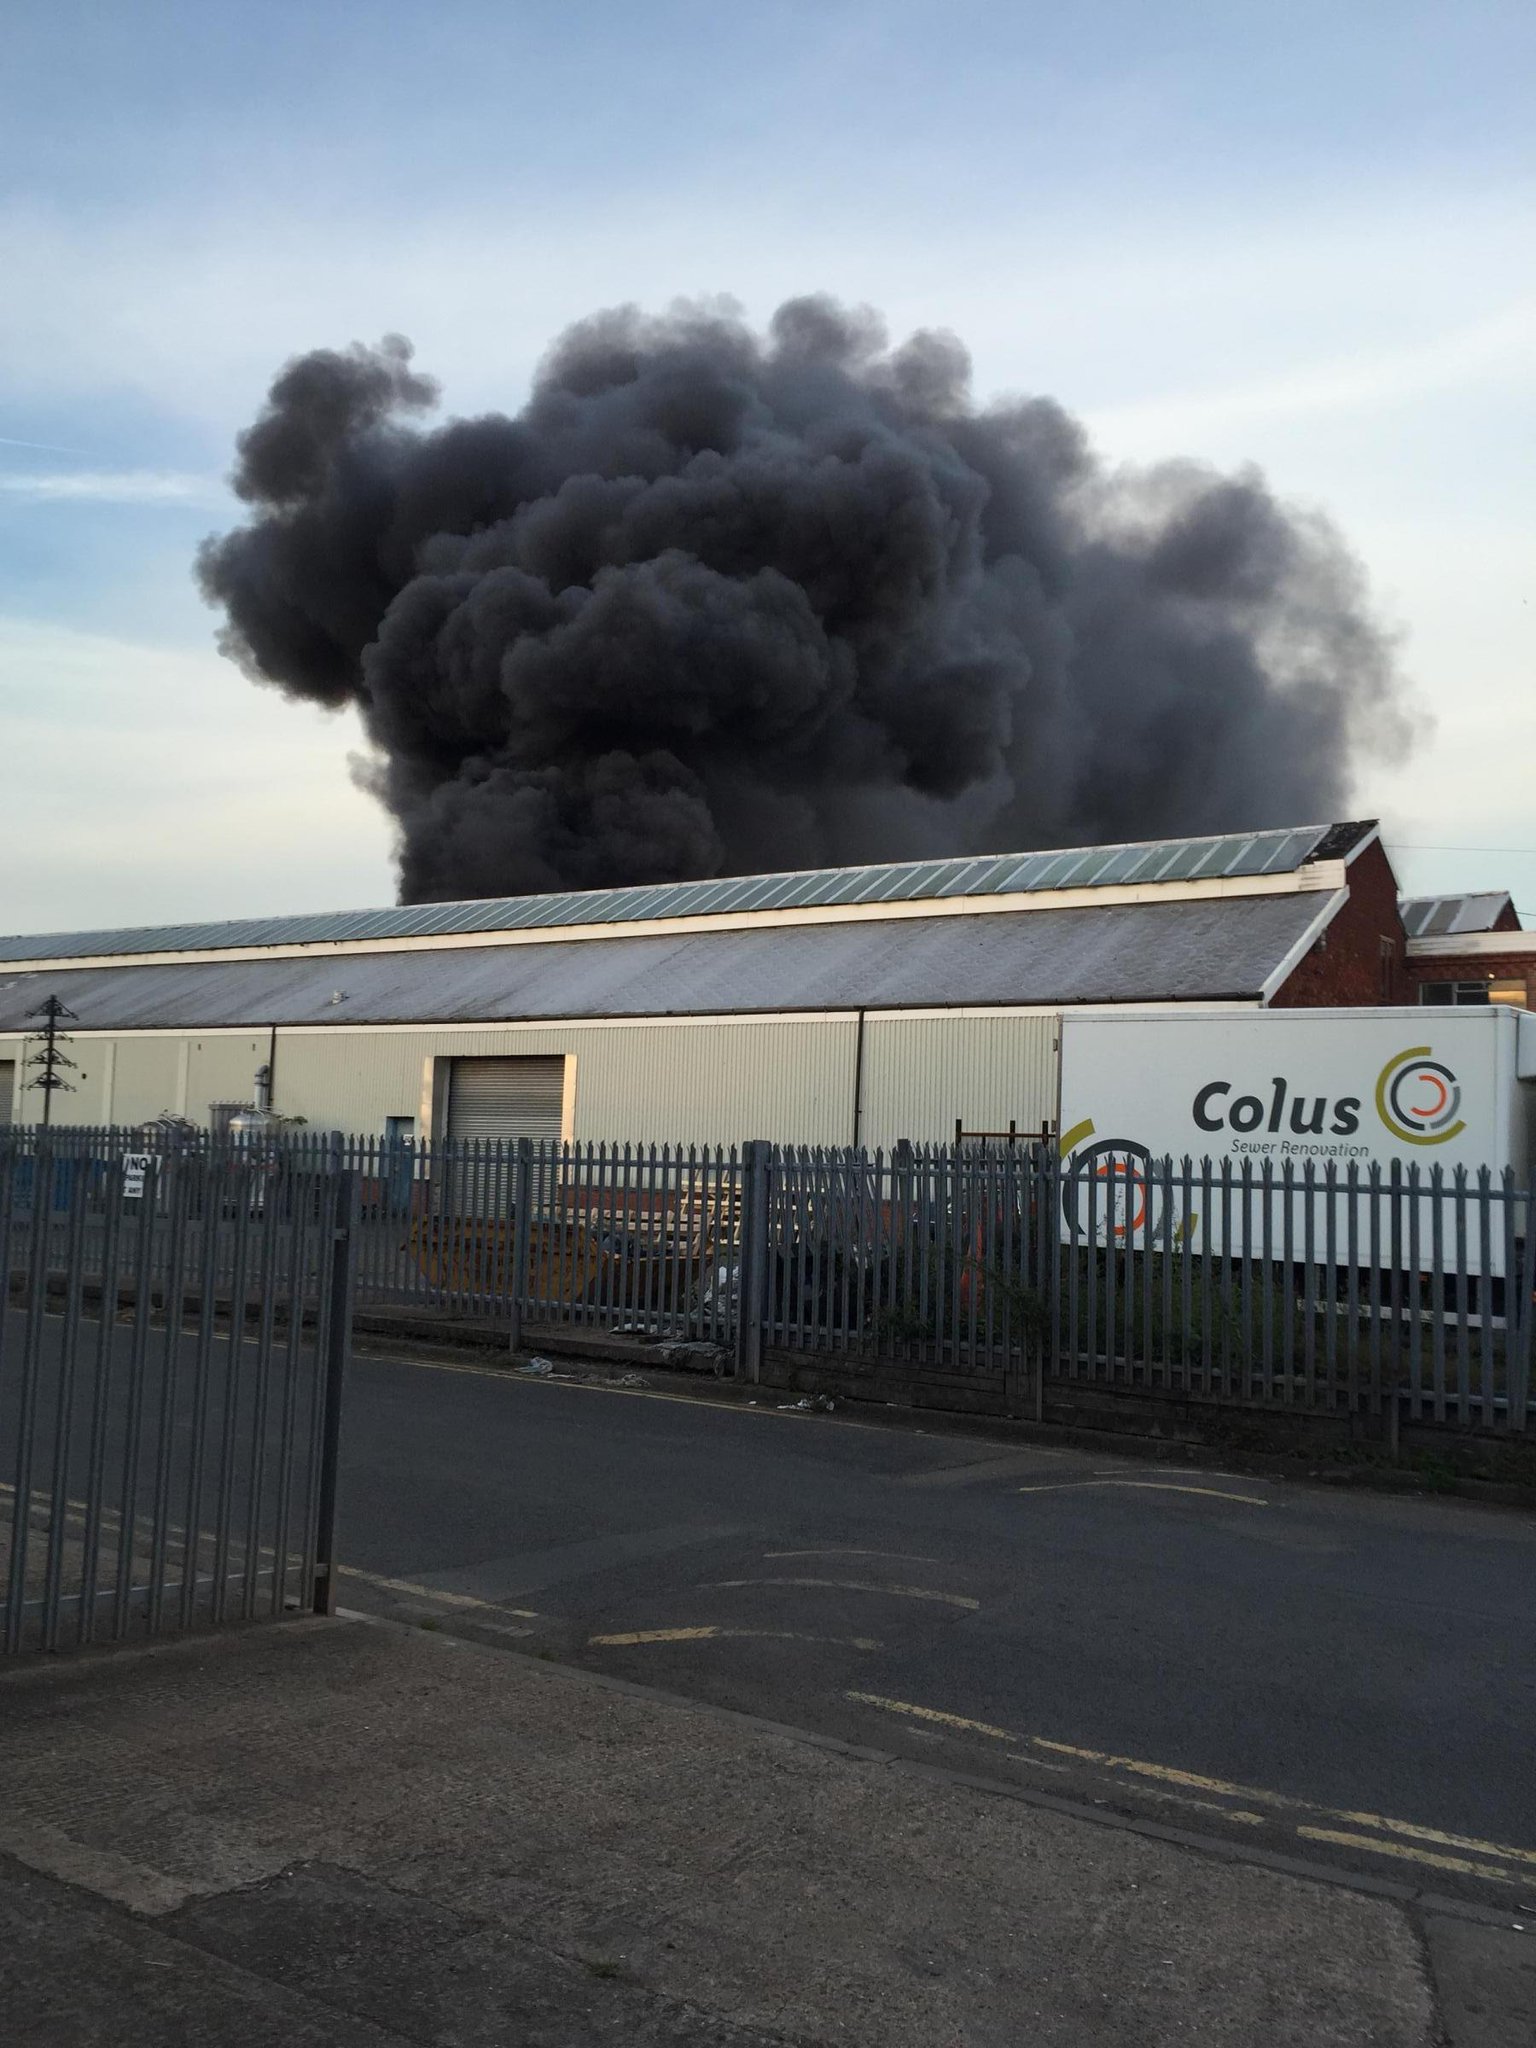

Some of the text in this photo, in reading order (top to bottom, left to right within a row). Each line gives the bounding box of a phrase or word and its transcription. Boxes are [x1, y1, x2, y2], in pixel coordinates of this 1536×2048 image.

[1193, 1077, 1361, 1135] Colus
[1231, 1140, 1369, 1157] Sewer Renovation
[131, 1157, 148, 1170] NO
